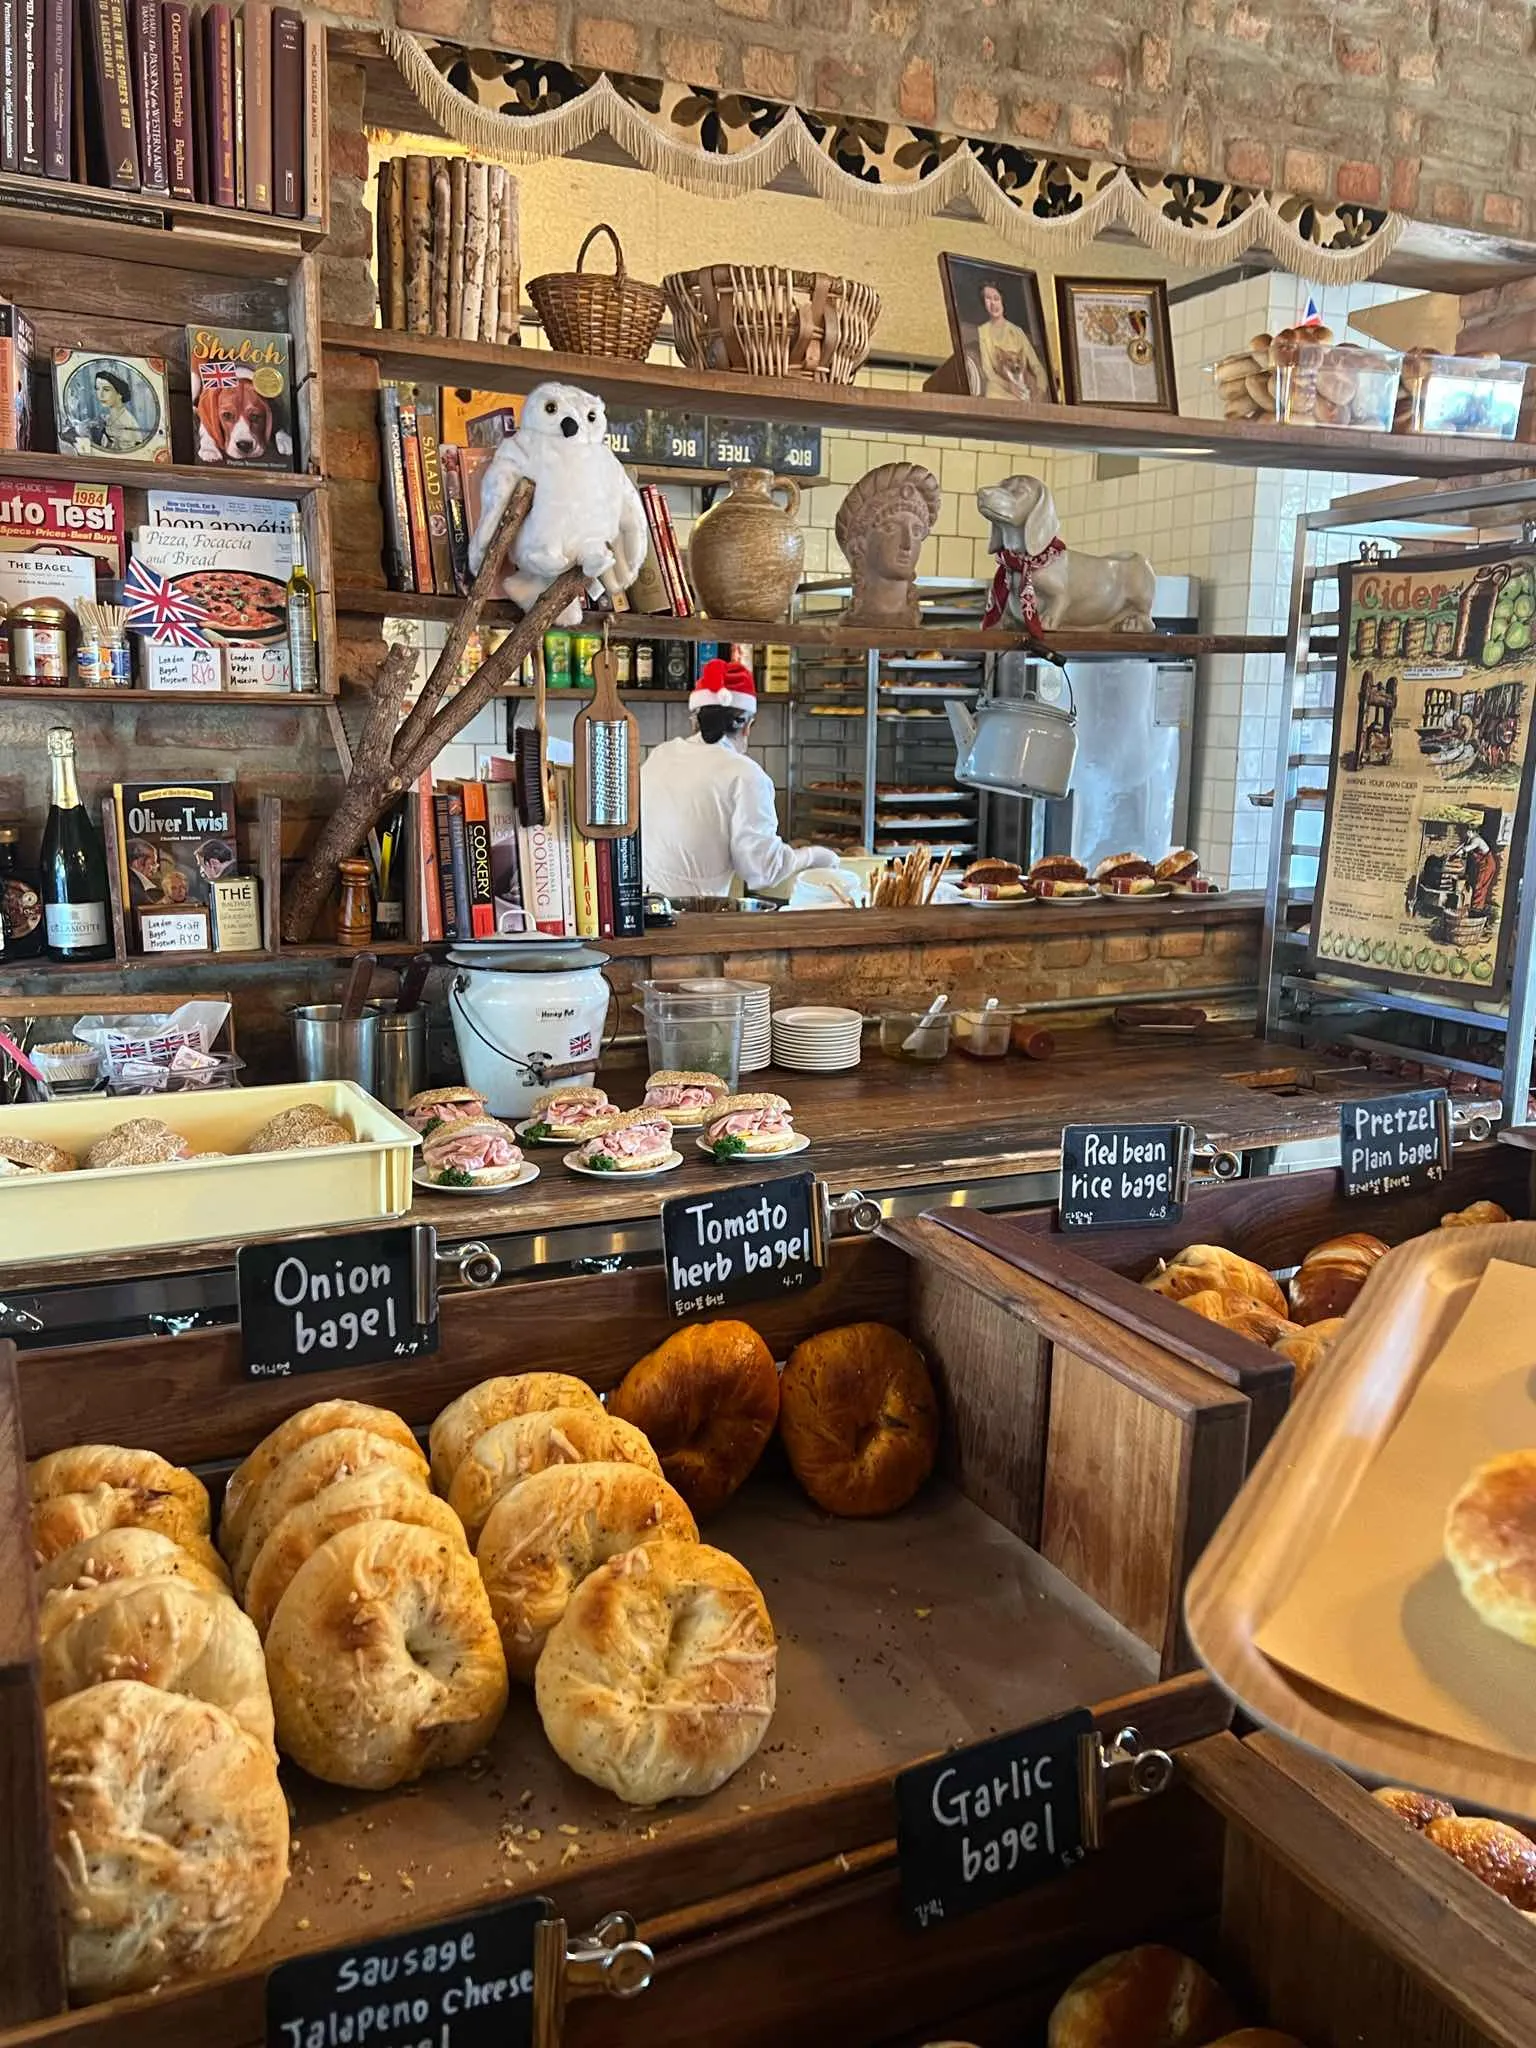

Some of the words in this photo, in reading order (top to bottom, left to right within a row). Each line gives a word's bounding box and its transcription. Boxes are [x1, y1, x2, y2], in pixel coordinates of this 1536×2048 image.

[111, 6, 122, 28] GIRL
[114, 30, 123, 41] IN
[5, 46, 13, 77] Methods
[115, 44, 125, 60] THE
[5, 88, 13, 115] Applied
[173, 87, 185, 127] Worship
[152, 109, 161, 154] WESTERN
[175, 139, 185, 180] Rayburn
[193, 331, 287, 364] Shiloh
[605, 434, 630, 452] TRE
[672, 439, 696, 457] BIG
[718, 445, 751, 463] TREE
[422, 436, 441, 495] SALAD
[75, 491, 104, 505] 1984
[0, 495, 45, 525] uto
[47, 498, 115, 530] Test
[0, 526, 31, 536] Specs
[35, 528, 67, 537] Prices
[71, 531, 93, 539] Best
[93, 533, 117, 544] Buys
[209, 519, 292, 535] appéti
[146, 531, 189, 548] Pizza,
[192, 534, 252, 550] Focaccia
[8, 560, 31, 570] THE
[35, 562, 73, 573] BAGEL
[146, 552, 167, 564] and
[172, 550, 221, 567] Bread
[1359, 576, 1448, 611] Cider
[158, 656, 184, 664] London
[230, 653, 254, 661] London
[191, 664, 215, 685] RYO
[128, 808, 182, 834] Oliver
[182, 808, 228, 832] Twist
[473, 825, 490, 899] COOKERY
[533, 825, 550, 905] COOKING
[620, 836, 629, 880] hopaedics
[219, 884, 252, 900] THÉ
[148, 919, 172, 929] London
[180, 934, 200, 945] RYO
[541, 1009, 563, 1018] Honey
[564, 1008, 574, 1017] Pot
[1354, 1099, 1435, 1140] Pretzel
[1084, 1132, 1117, 1167] Red
[1123, 1134, 1166, 1164] bean
[1352, 1147, 1392, 1175] Plain
[1399, 1137, 1439, 1169] bagel
[1071, 1172, 1112, 1200] rice
[1121, 1171, 1173, 1200] bagel
[685, 1197, 787, 1246] Tomato
[1149, 1206, 1167, 1218] 4.8
[672, 1252, 733, 1291] herb
[744, 1228, 811, 1275] bagel
[273, 1256, 391, 1307] Onion
[783, 1273, 803, 1287] 4.7
[675, 1296, 705, 1317] 토마토
[705, 1292, 726, 1307] 허브
[295, 1296, 397, 1355] bagel
[393, 1342, 419, 1356] 4.7
[250, 1360, 293, 1377] 어니언
[932, 1756, 1053, 1827] Garlic
[962, 1802, 1055, 1882] bagel
[335, 1930, 476, 1994] Sausage
[281, 1997, 429, 2048] Jalapeno
